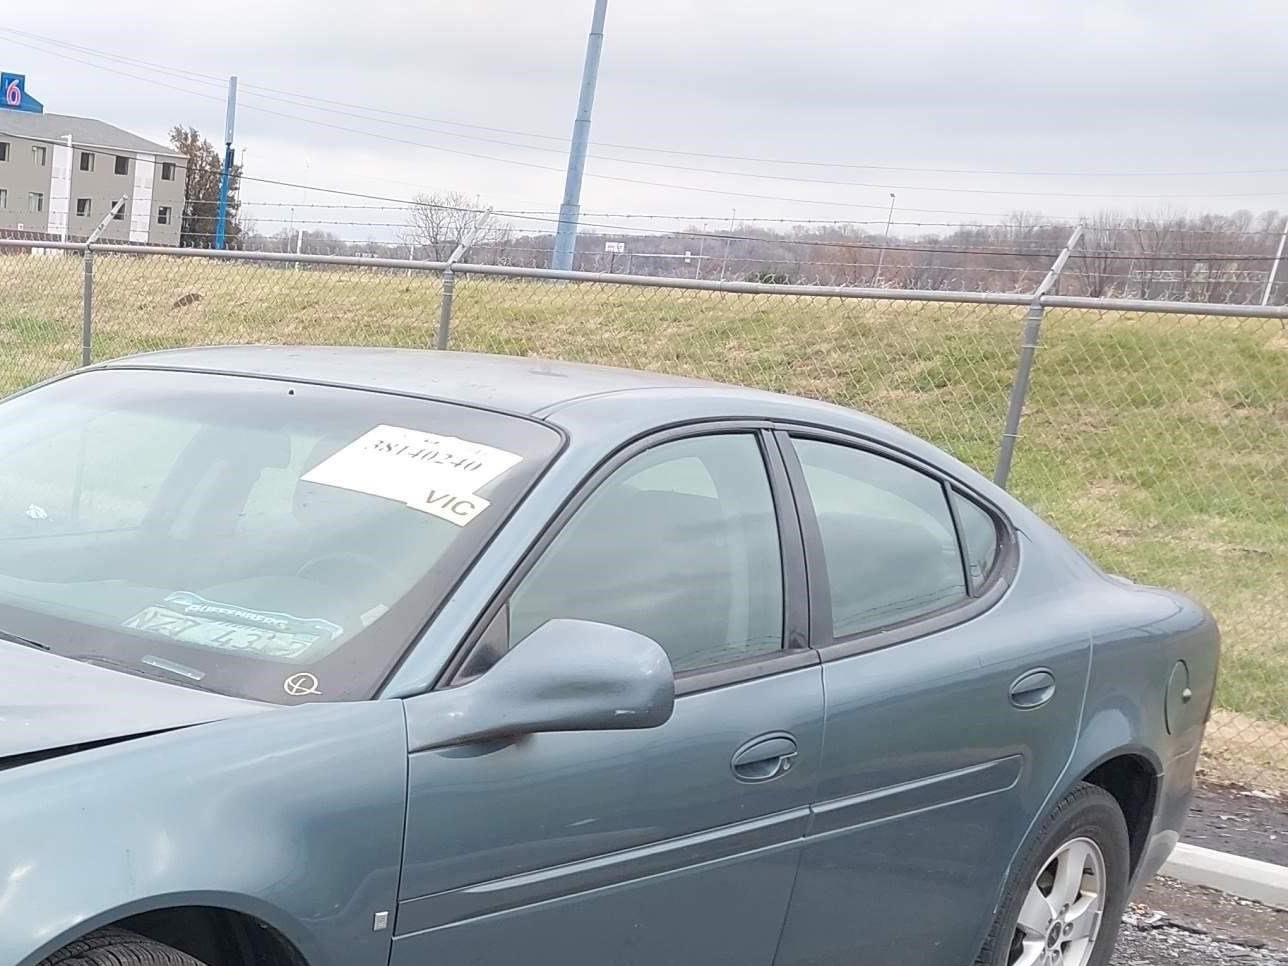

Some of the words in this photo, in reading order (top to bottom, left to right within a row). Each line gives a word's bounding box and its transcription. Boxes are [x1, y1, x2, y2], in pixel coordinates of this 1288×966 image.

[6, 78, 22, 106] 6
[374, 439, 483, 472] 38140240
[425, 489, 476, 516] VIC
